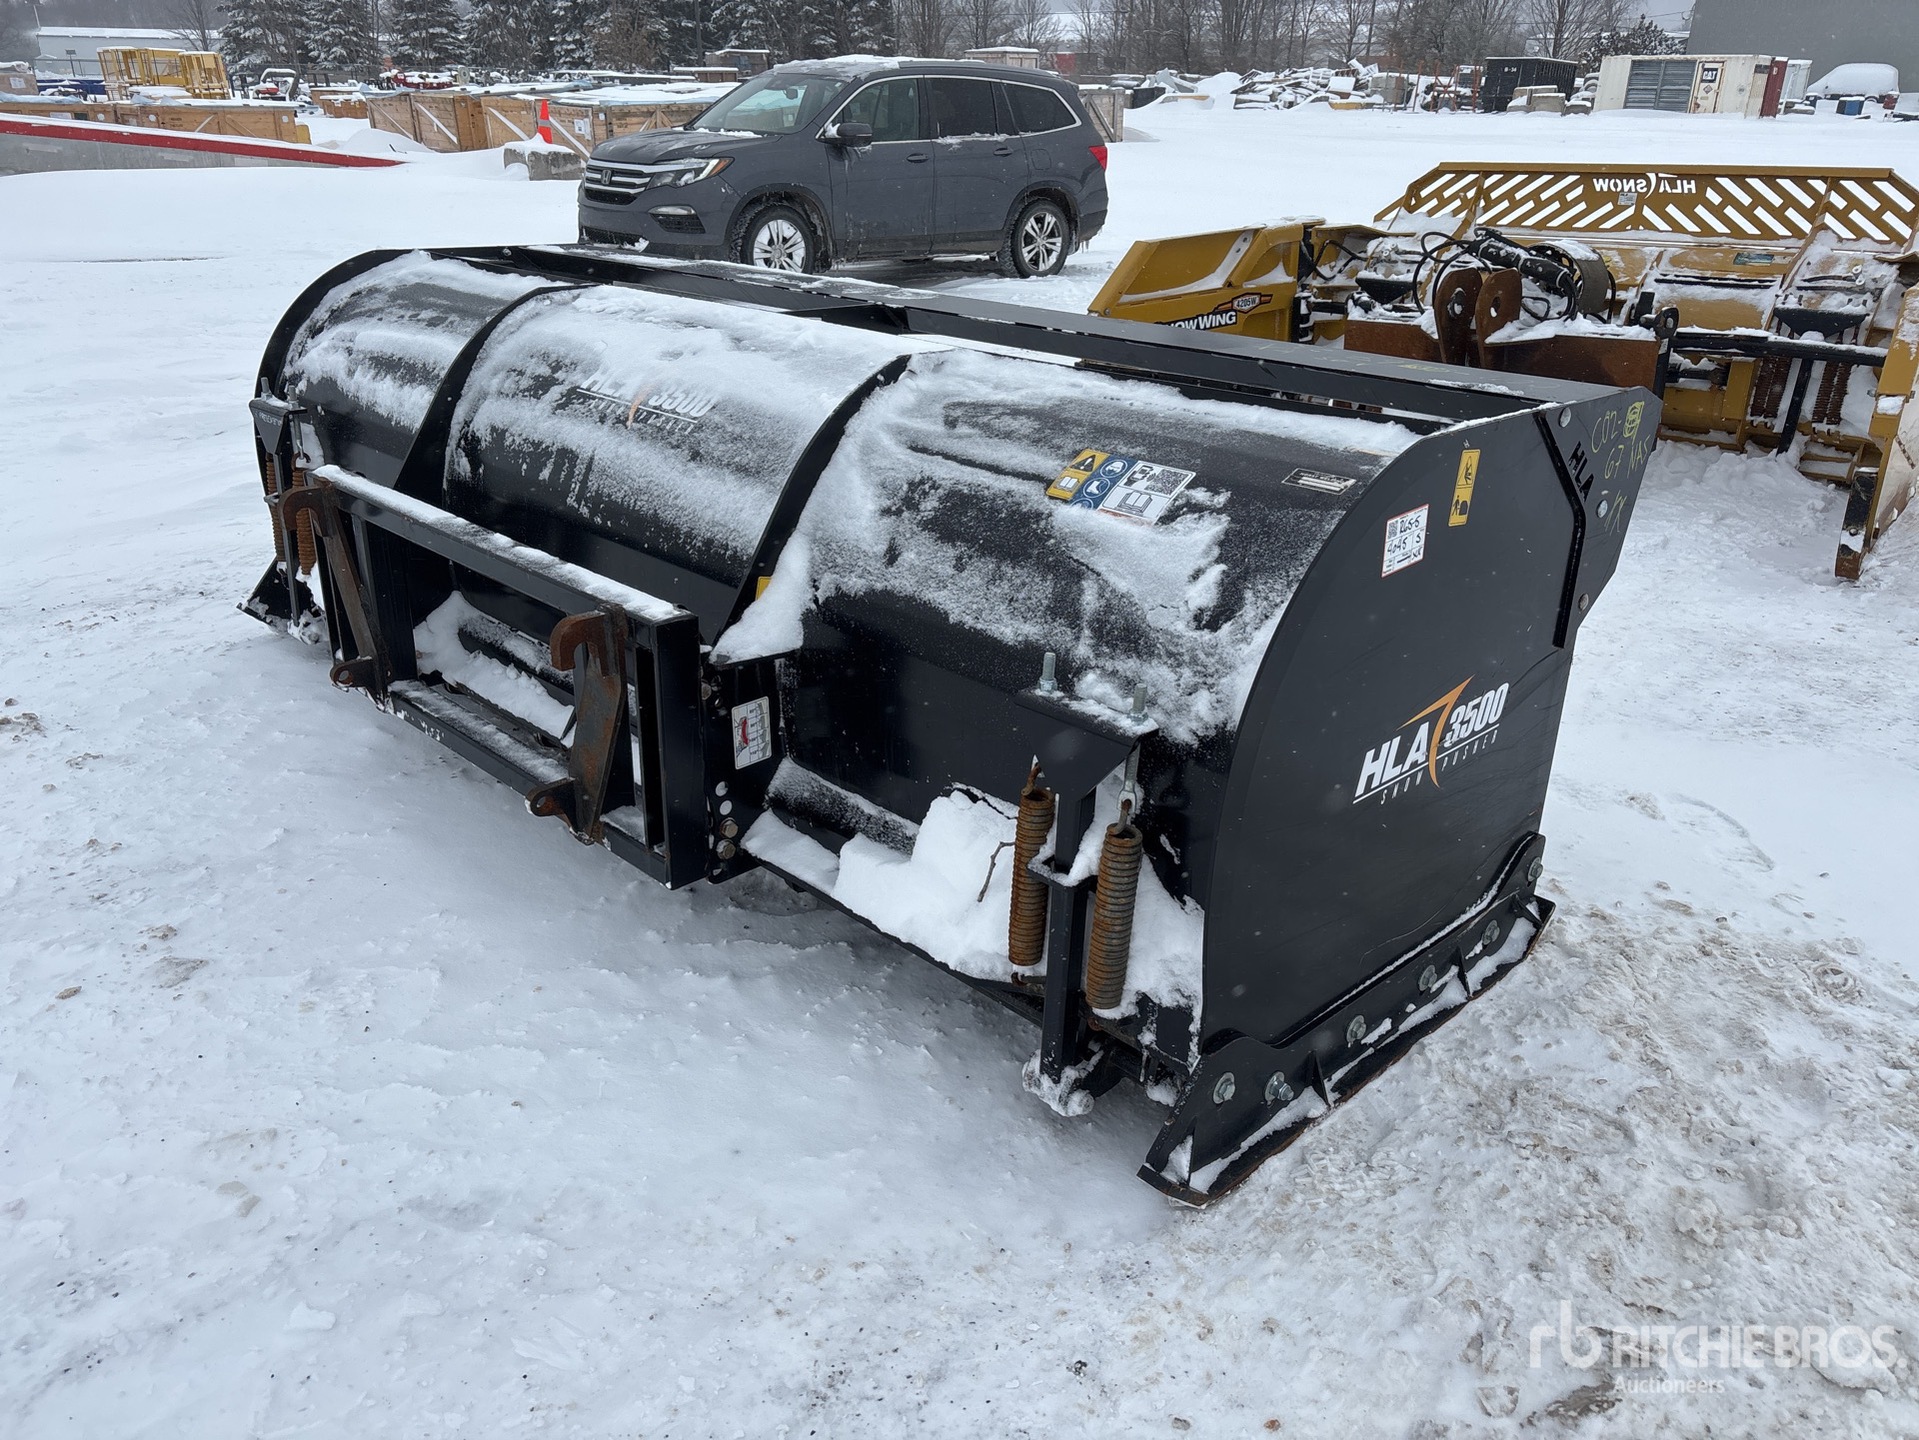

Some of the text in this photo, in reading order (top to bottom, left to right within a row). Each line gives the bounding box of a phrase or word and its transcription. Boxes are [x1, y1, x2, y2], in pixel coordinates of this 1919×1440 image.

[1702, 70, 1718, 80] CAT
[1568, 440, 1595, 503] HLA
[1355, 682, 1510, 798] HLA 3500
[1380, 729, 1498, 805] SNOW PUSHER
